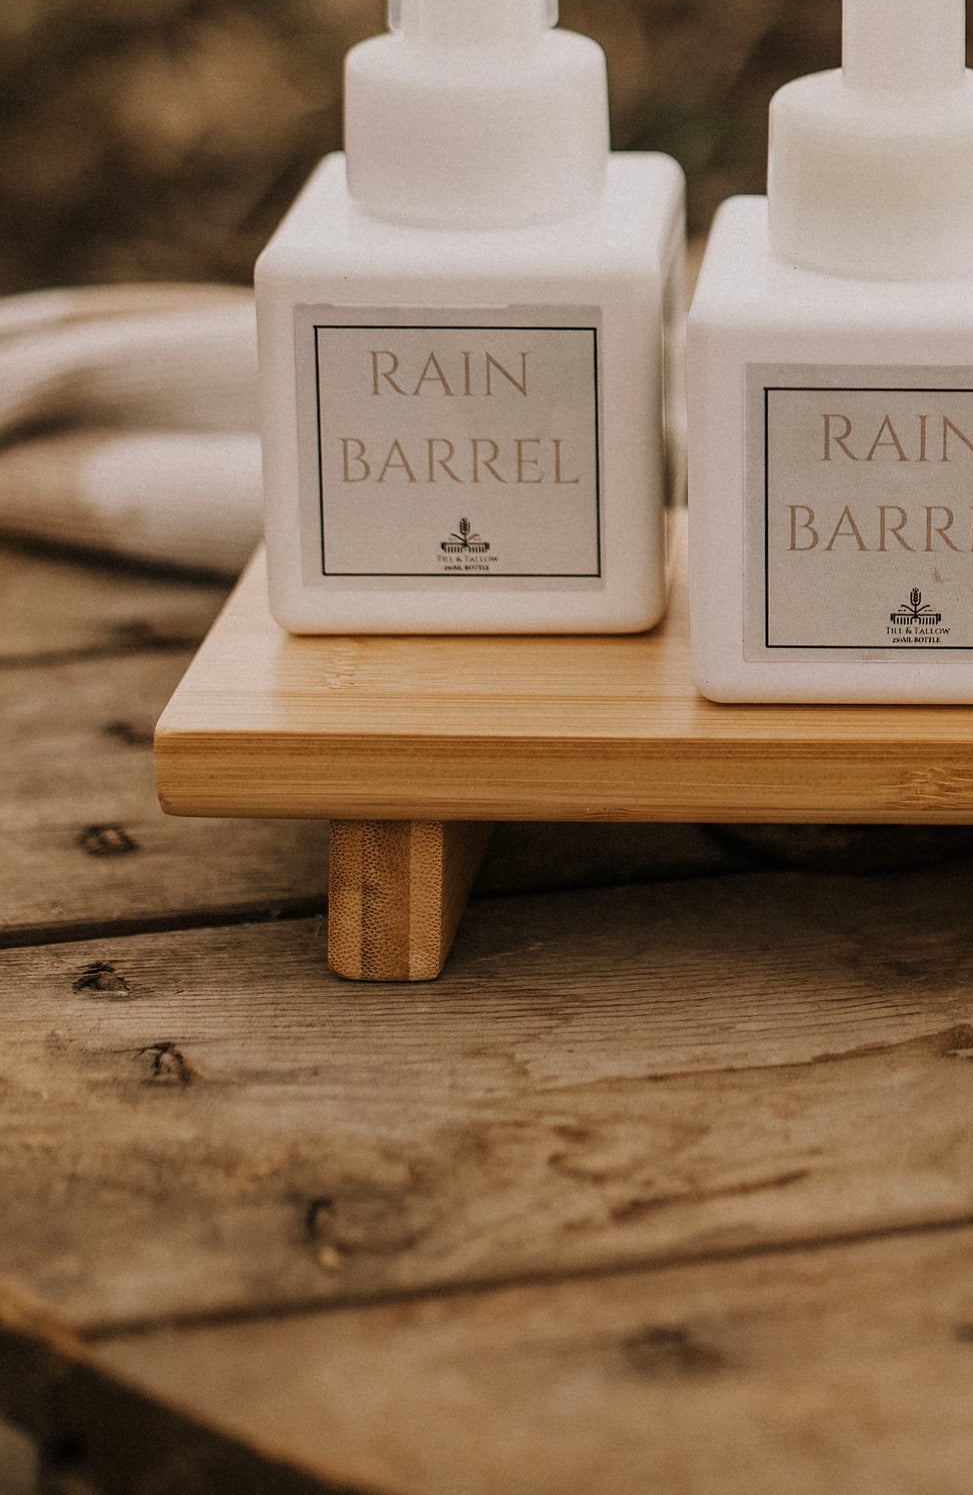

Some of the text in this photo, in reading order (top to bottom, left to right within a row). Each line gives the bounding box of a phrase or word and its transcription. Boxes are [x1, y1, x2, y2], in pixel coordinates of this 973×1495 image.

[369, 350, 529, 397] RAIN
[339, 437, 582, 484] BARREL
[885, 626, 951, 635] TILL & TALLOW
